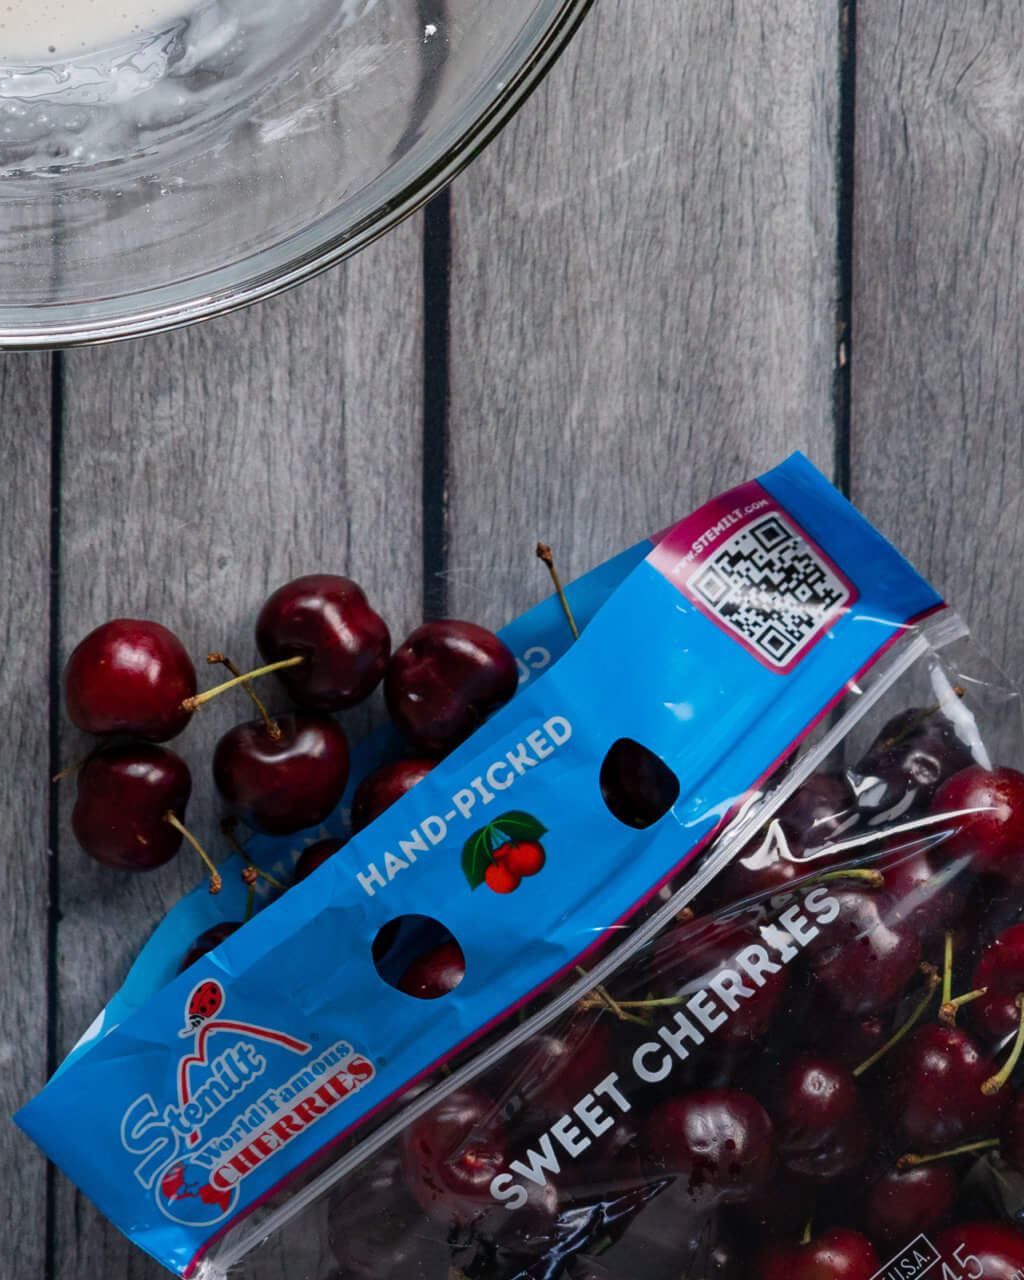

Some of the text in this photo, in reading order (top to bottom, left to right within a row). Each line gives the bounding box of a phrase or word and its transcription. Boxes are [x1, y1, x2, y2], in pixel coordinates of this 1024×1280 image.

[356, 715, 573, 897] HAND-PICKED
[121, 1041, 266, 1189] Stemilt
[191, 1040, 355, 1169] World Famous
[489, 886, 841, 1210] SWEET CHERRIES
[209, 1055, 376, 1191] CHERRIES
